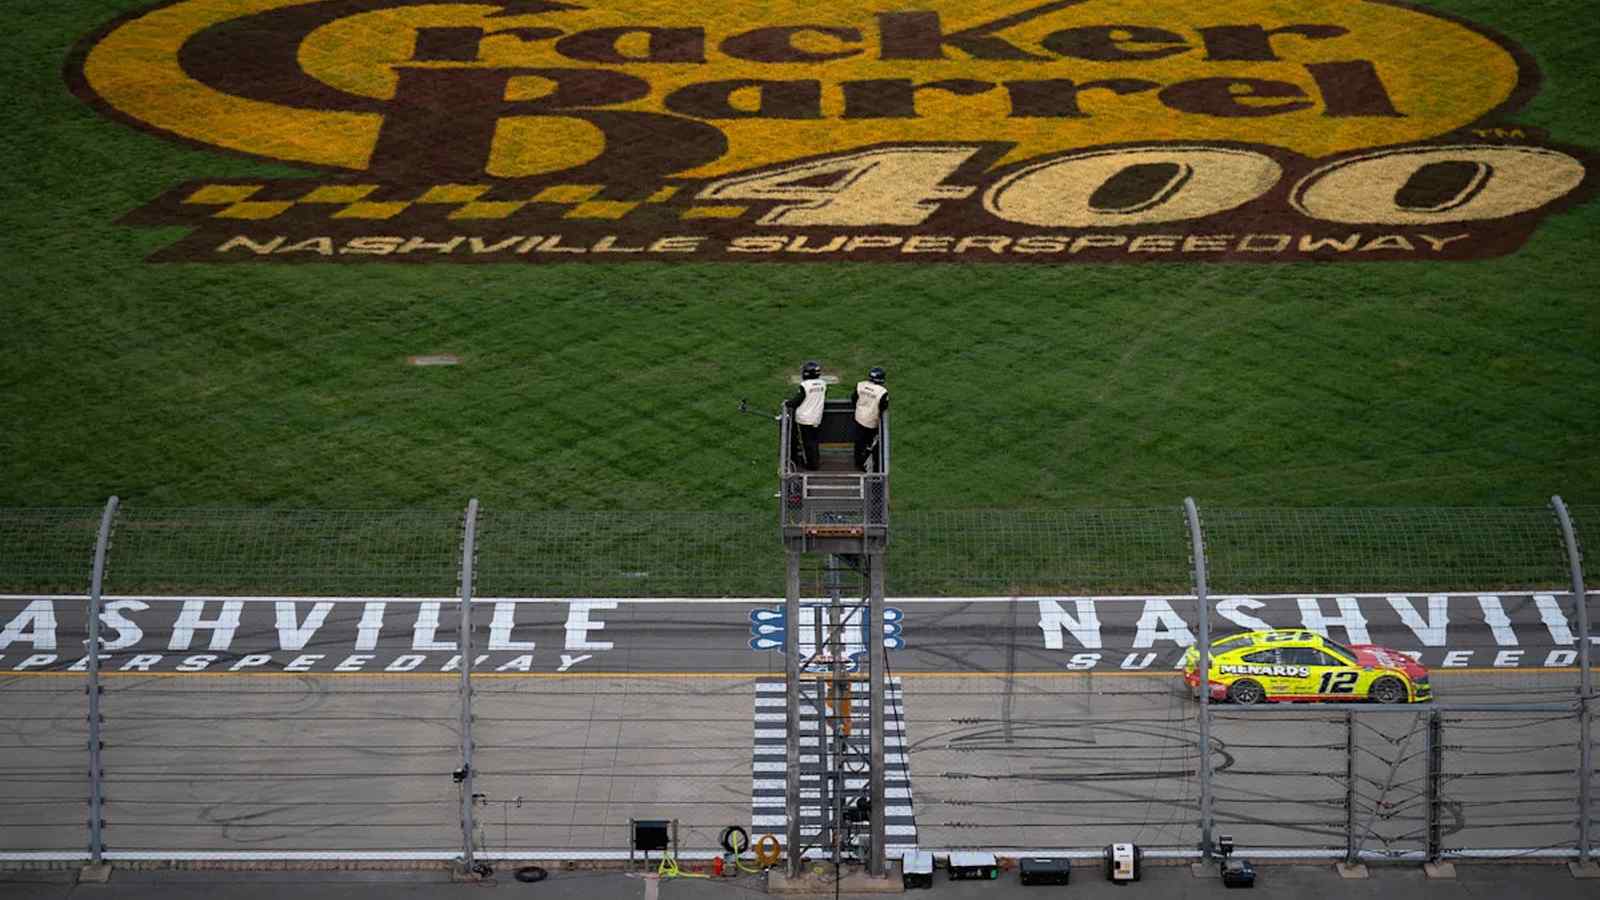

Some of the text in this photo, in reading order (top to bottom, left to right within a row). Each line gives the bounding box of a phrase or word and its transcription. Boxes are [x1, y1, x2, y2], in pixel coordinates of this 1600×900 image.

[177, 0, 1351, 113] Cracker
[362, 59, 1408, 180] Barrel
[694, 145, 1586, 227] 400
[215, 233, 1471, 254] NASHVILLE SUPERSPEEDWAY
[0, 653, 593, 672] PERSPEEDWAY
[1219, 664, 1310, 679] MENARDS
[1318, 672, 1359, 694] 12
